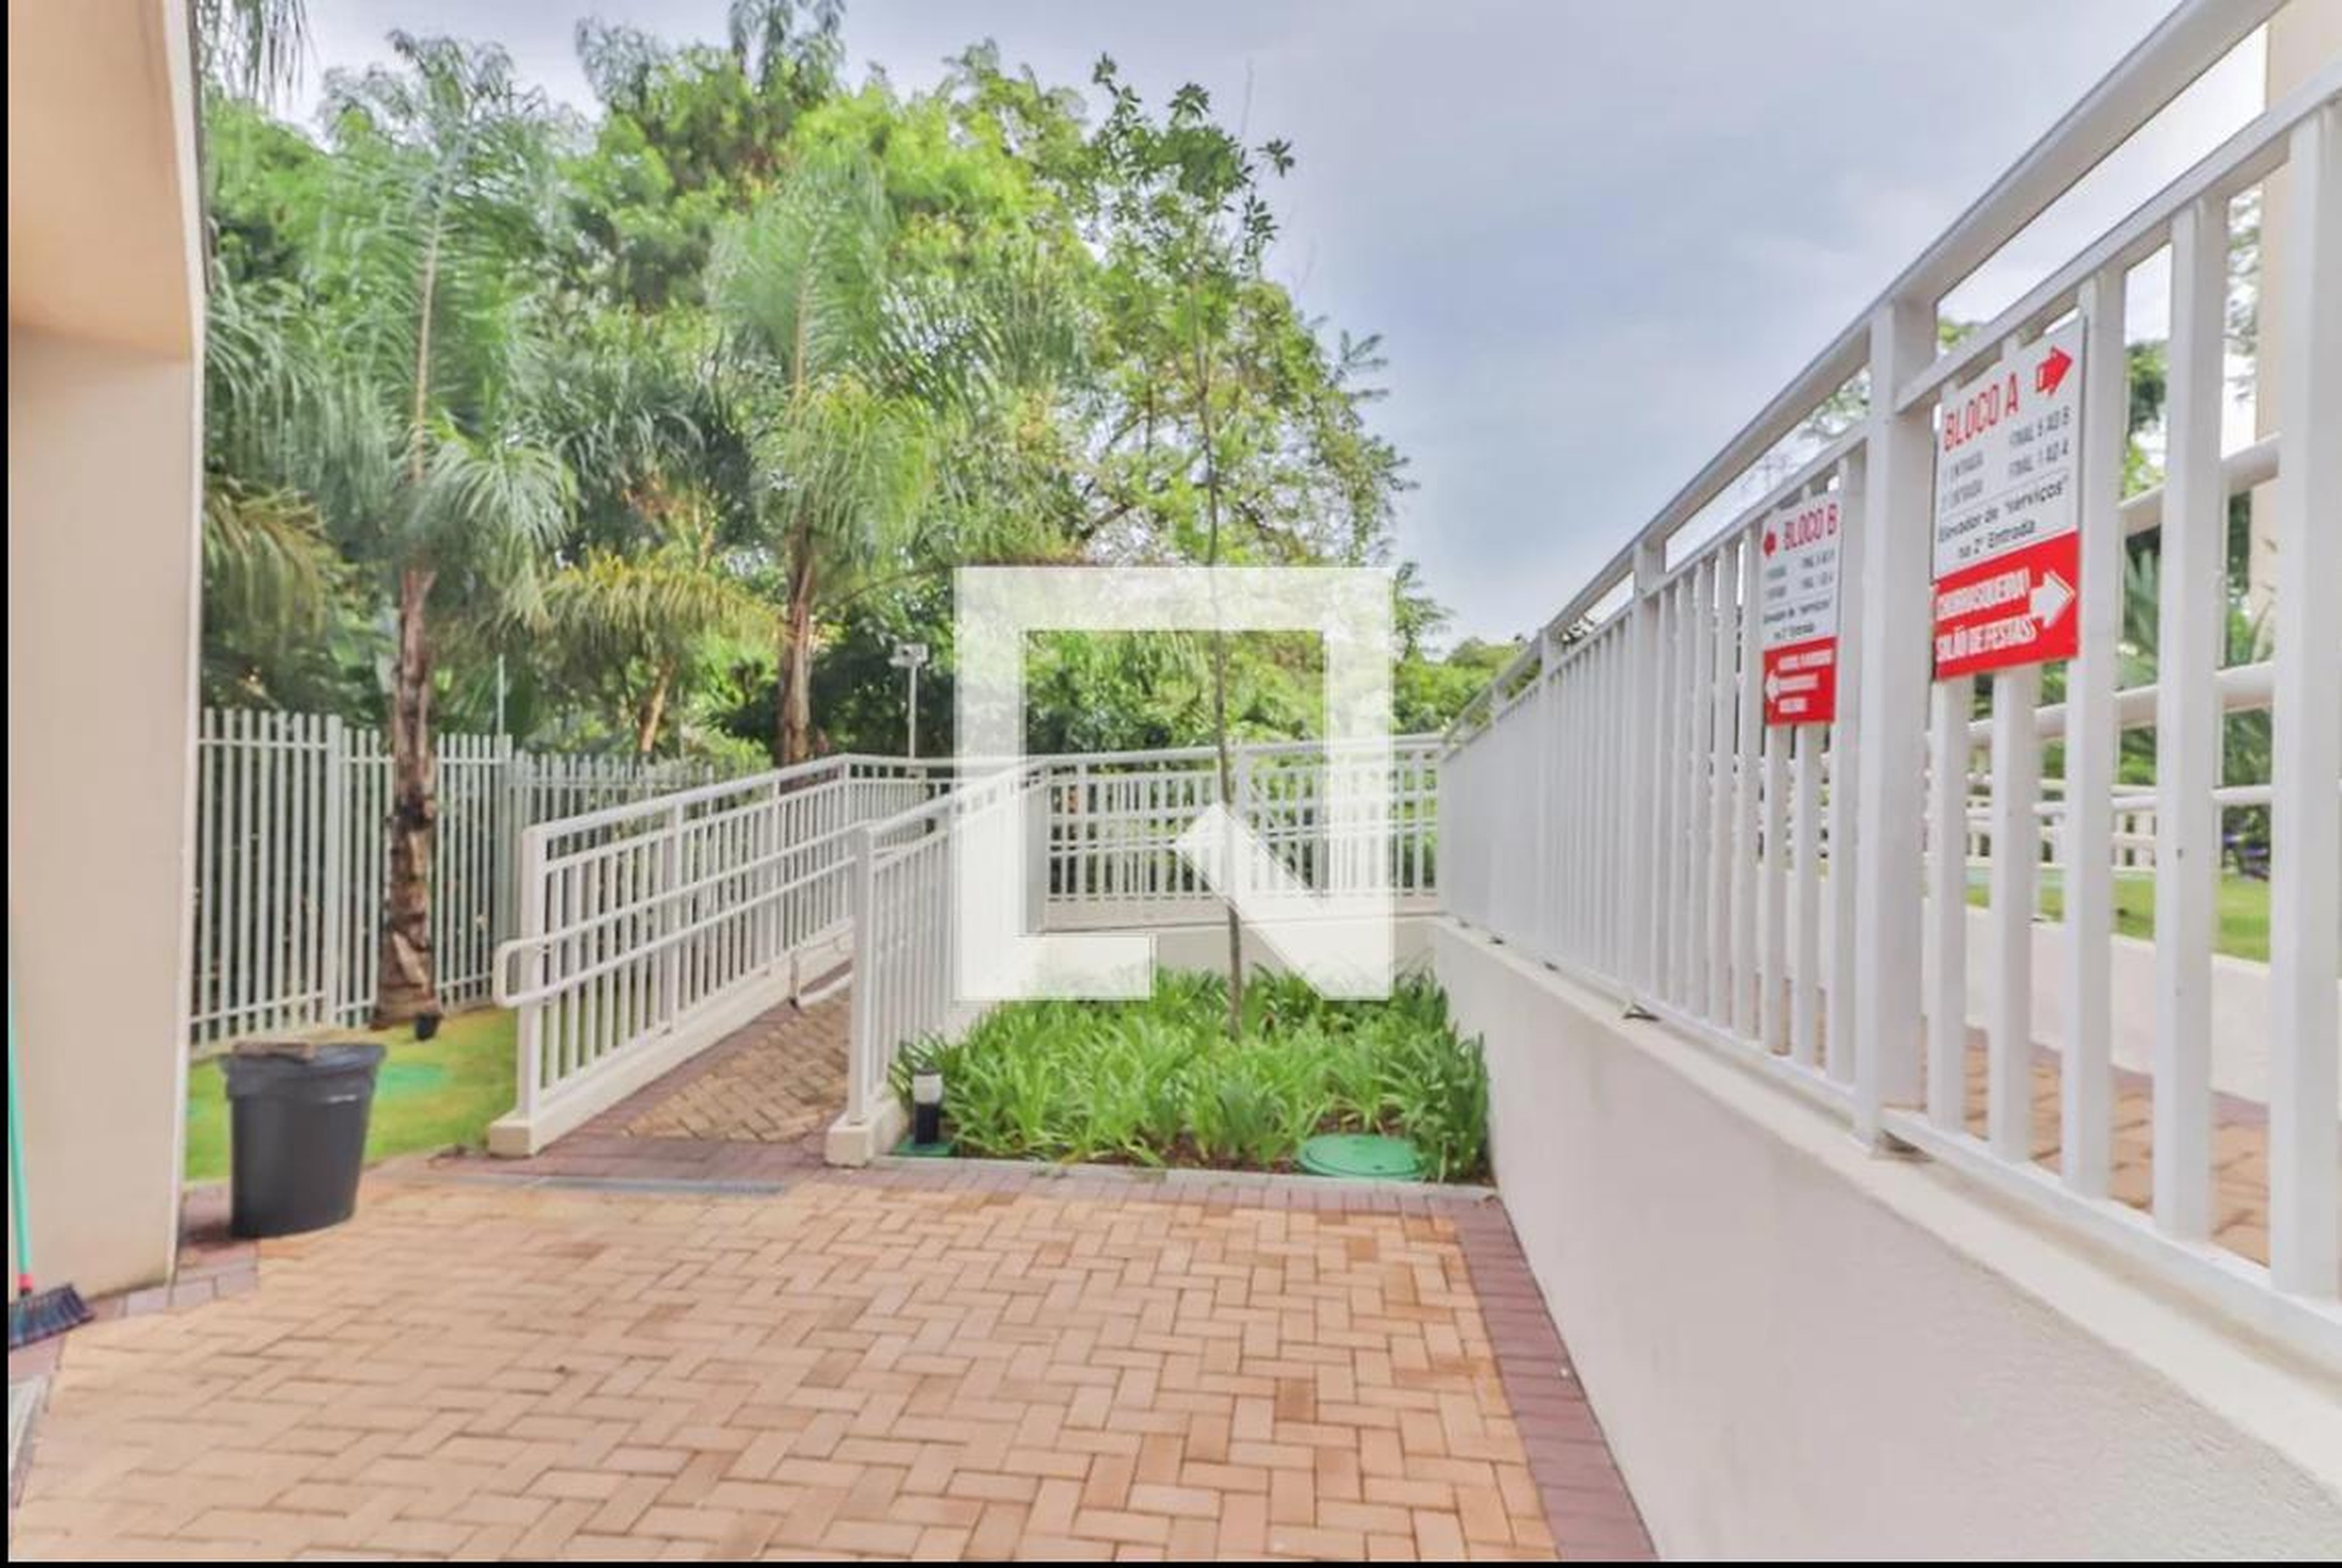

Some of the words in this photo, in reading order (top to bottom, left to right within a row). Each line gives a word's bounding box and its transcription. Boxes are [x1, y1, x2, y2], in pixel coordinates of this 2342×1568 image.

[1944, 384, 1999, 453] BLOCO
[2005, 370, 2019, 416] A
[1785, 508, 1824, 551] BLOCO
[1828, 503, 1836, 537] B
